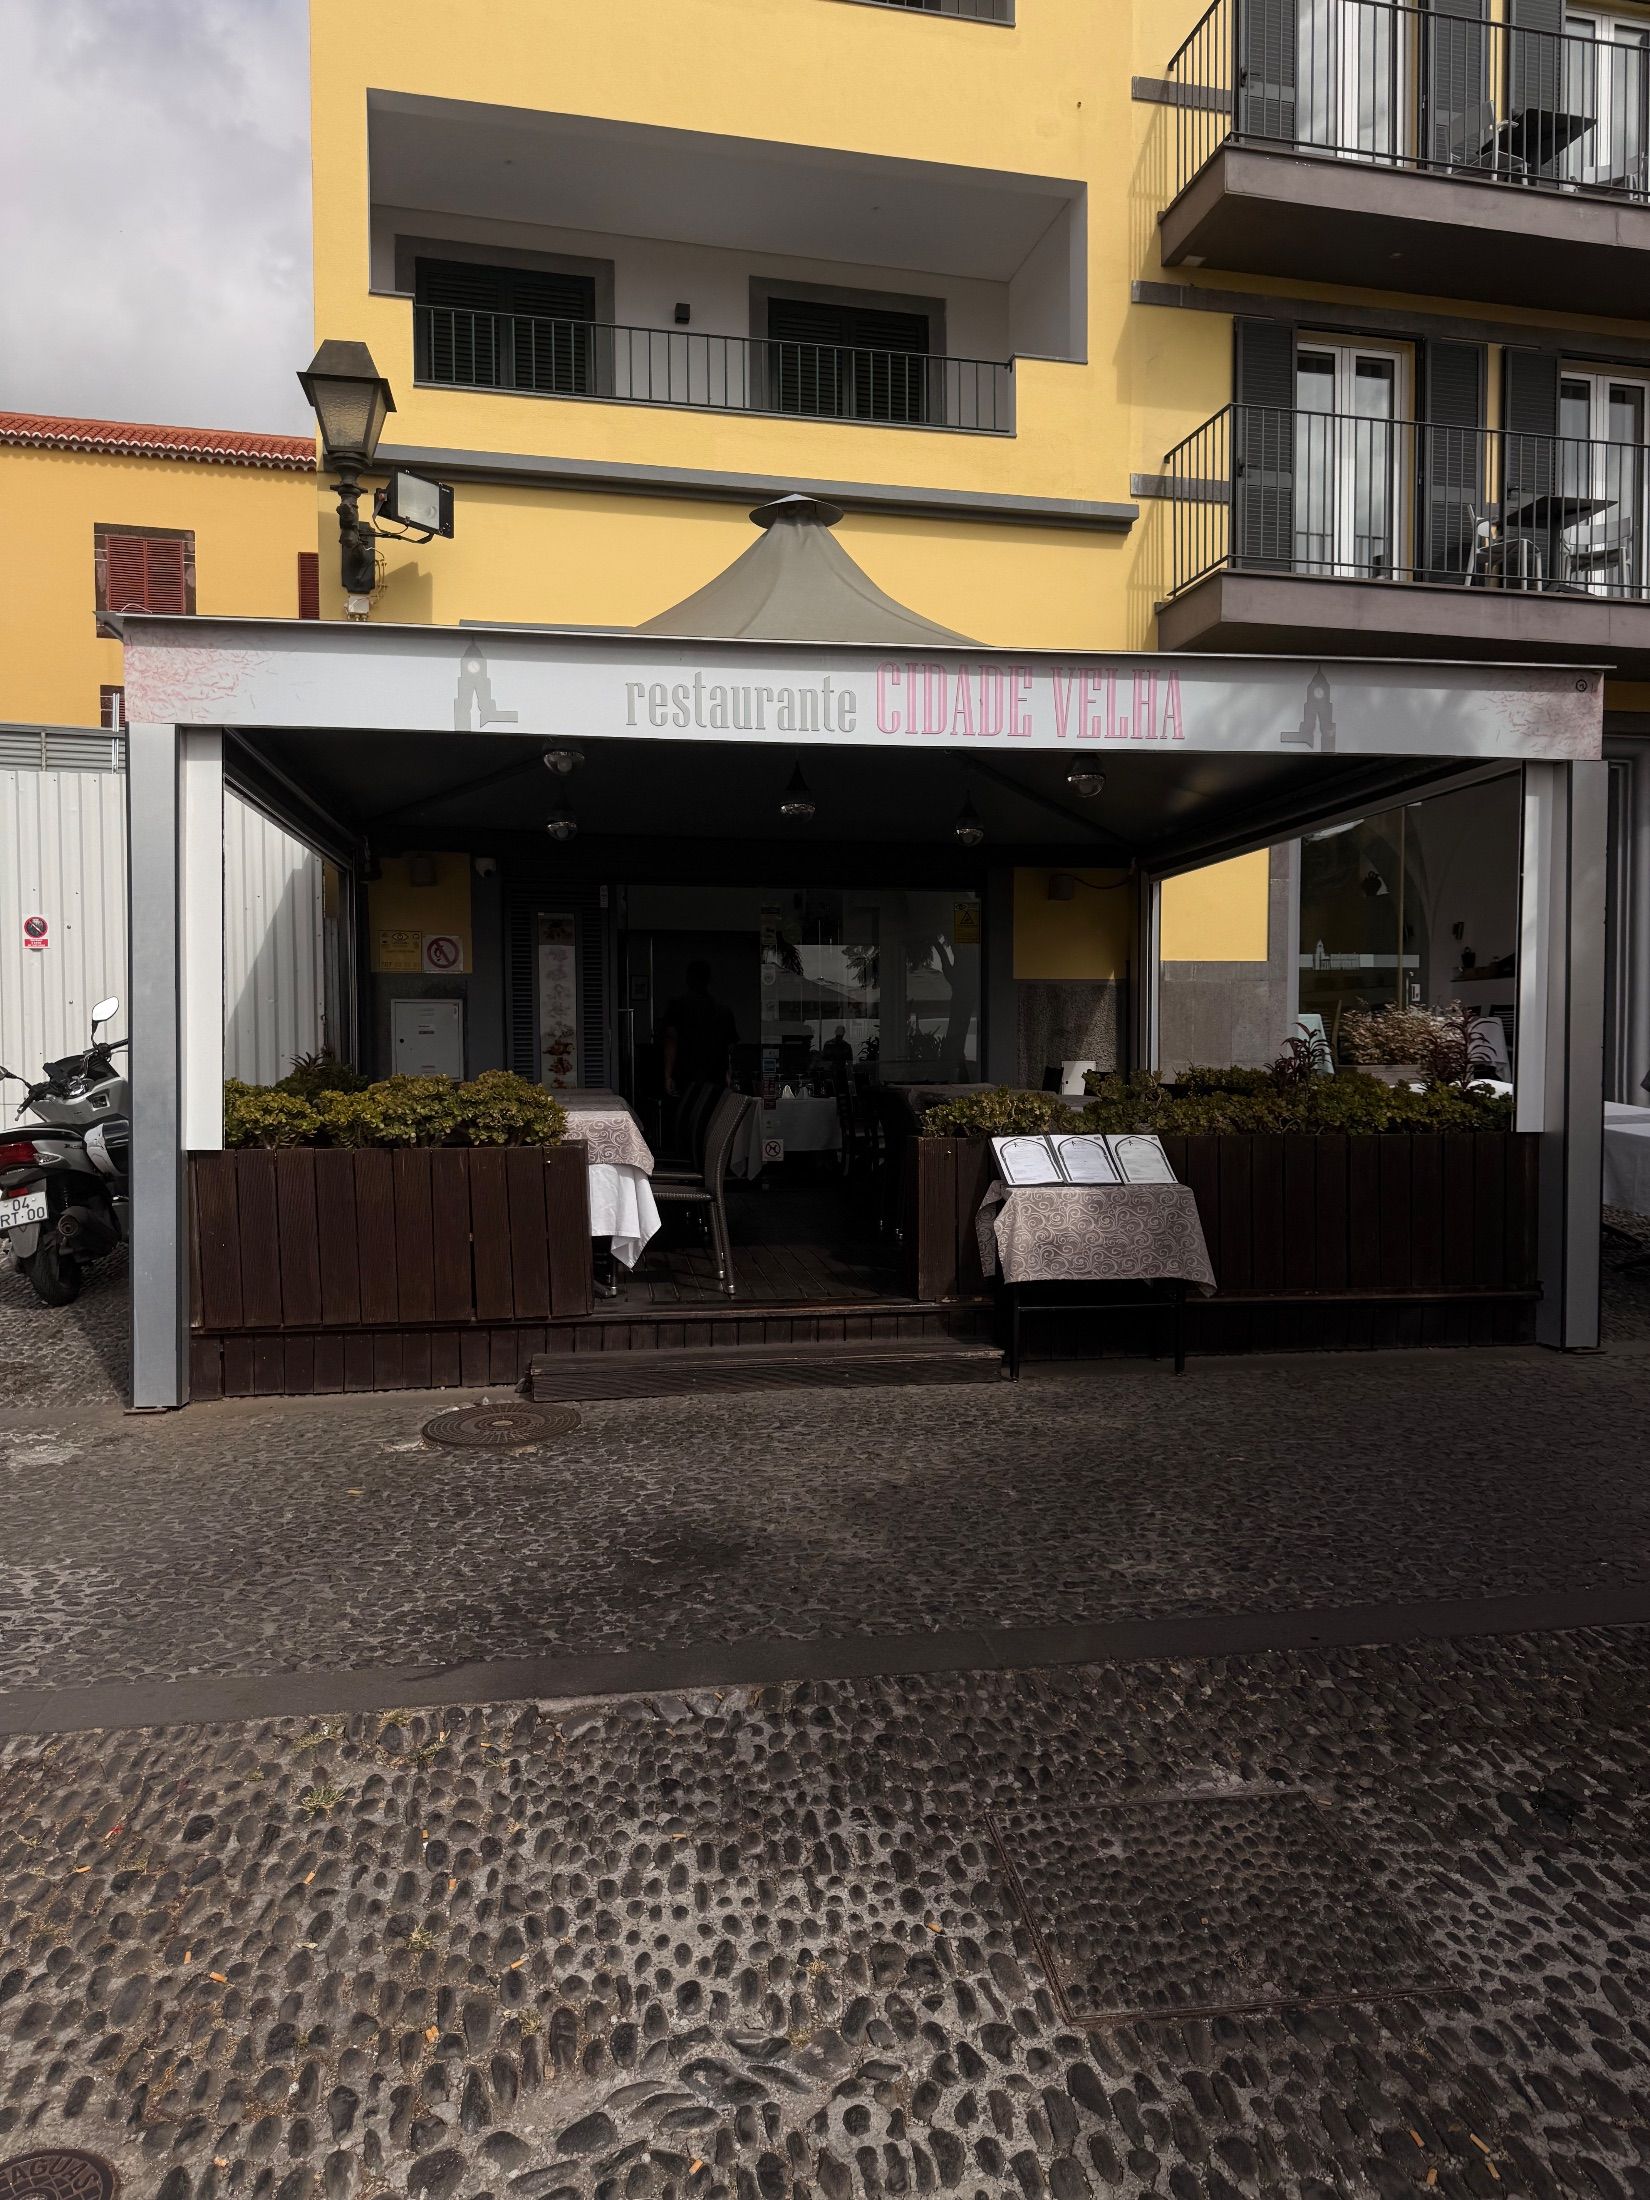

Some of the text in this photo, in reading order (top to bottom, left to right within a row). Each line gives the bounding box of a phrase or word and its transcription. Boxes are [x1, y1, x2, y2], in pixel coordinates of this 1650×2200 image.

[625, 661, 1186, 740] restaurante CIDADE VELHA
[12, 1197, 30, 1212] 04
